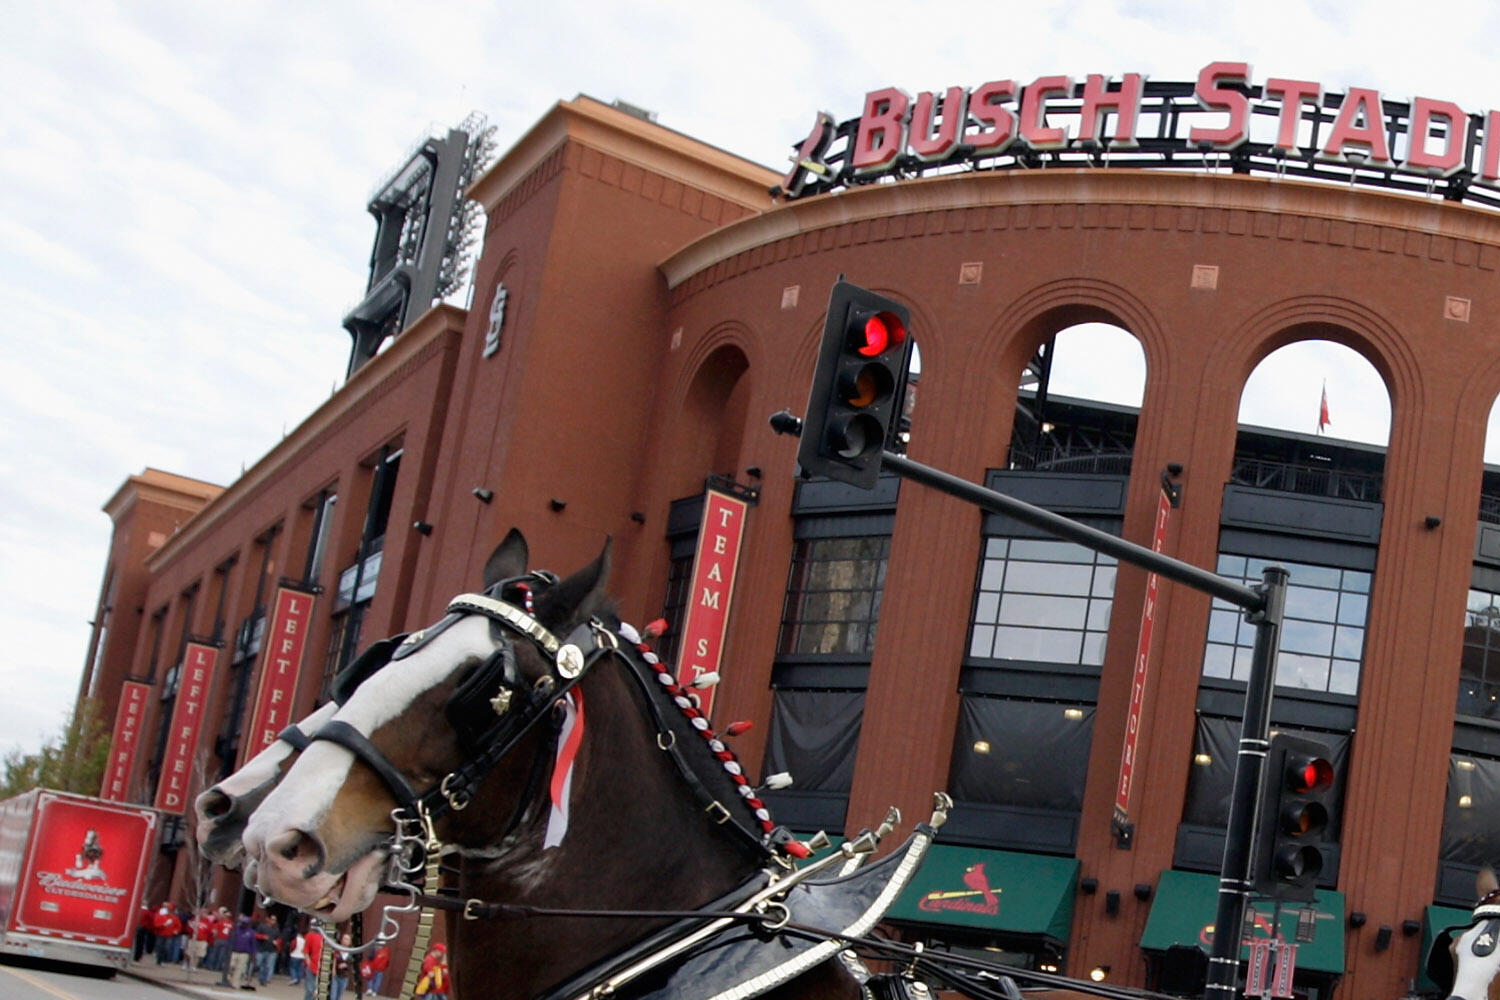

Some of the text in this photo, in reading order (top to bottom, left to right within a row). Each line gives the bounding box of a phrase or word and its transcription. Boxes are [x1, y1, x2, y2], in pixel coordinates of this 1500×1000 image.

[852, 73, 1143, 172] BUSCH
[700, 507, 733, 610] TEAM
[277, 600, 300, 674] LEFT
[122, 688, 142, 742] LEFT
[165, 652, 206, 807] LEFT FIELD
[1120, 653, 1145, 796] STORE
